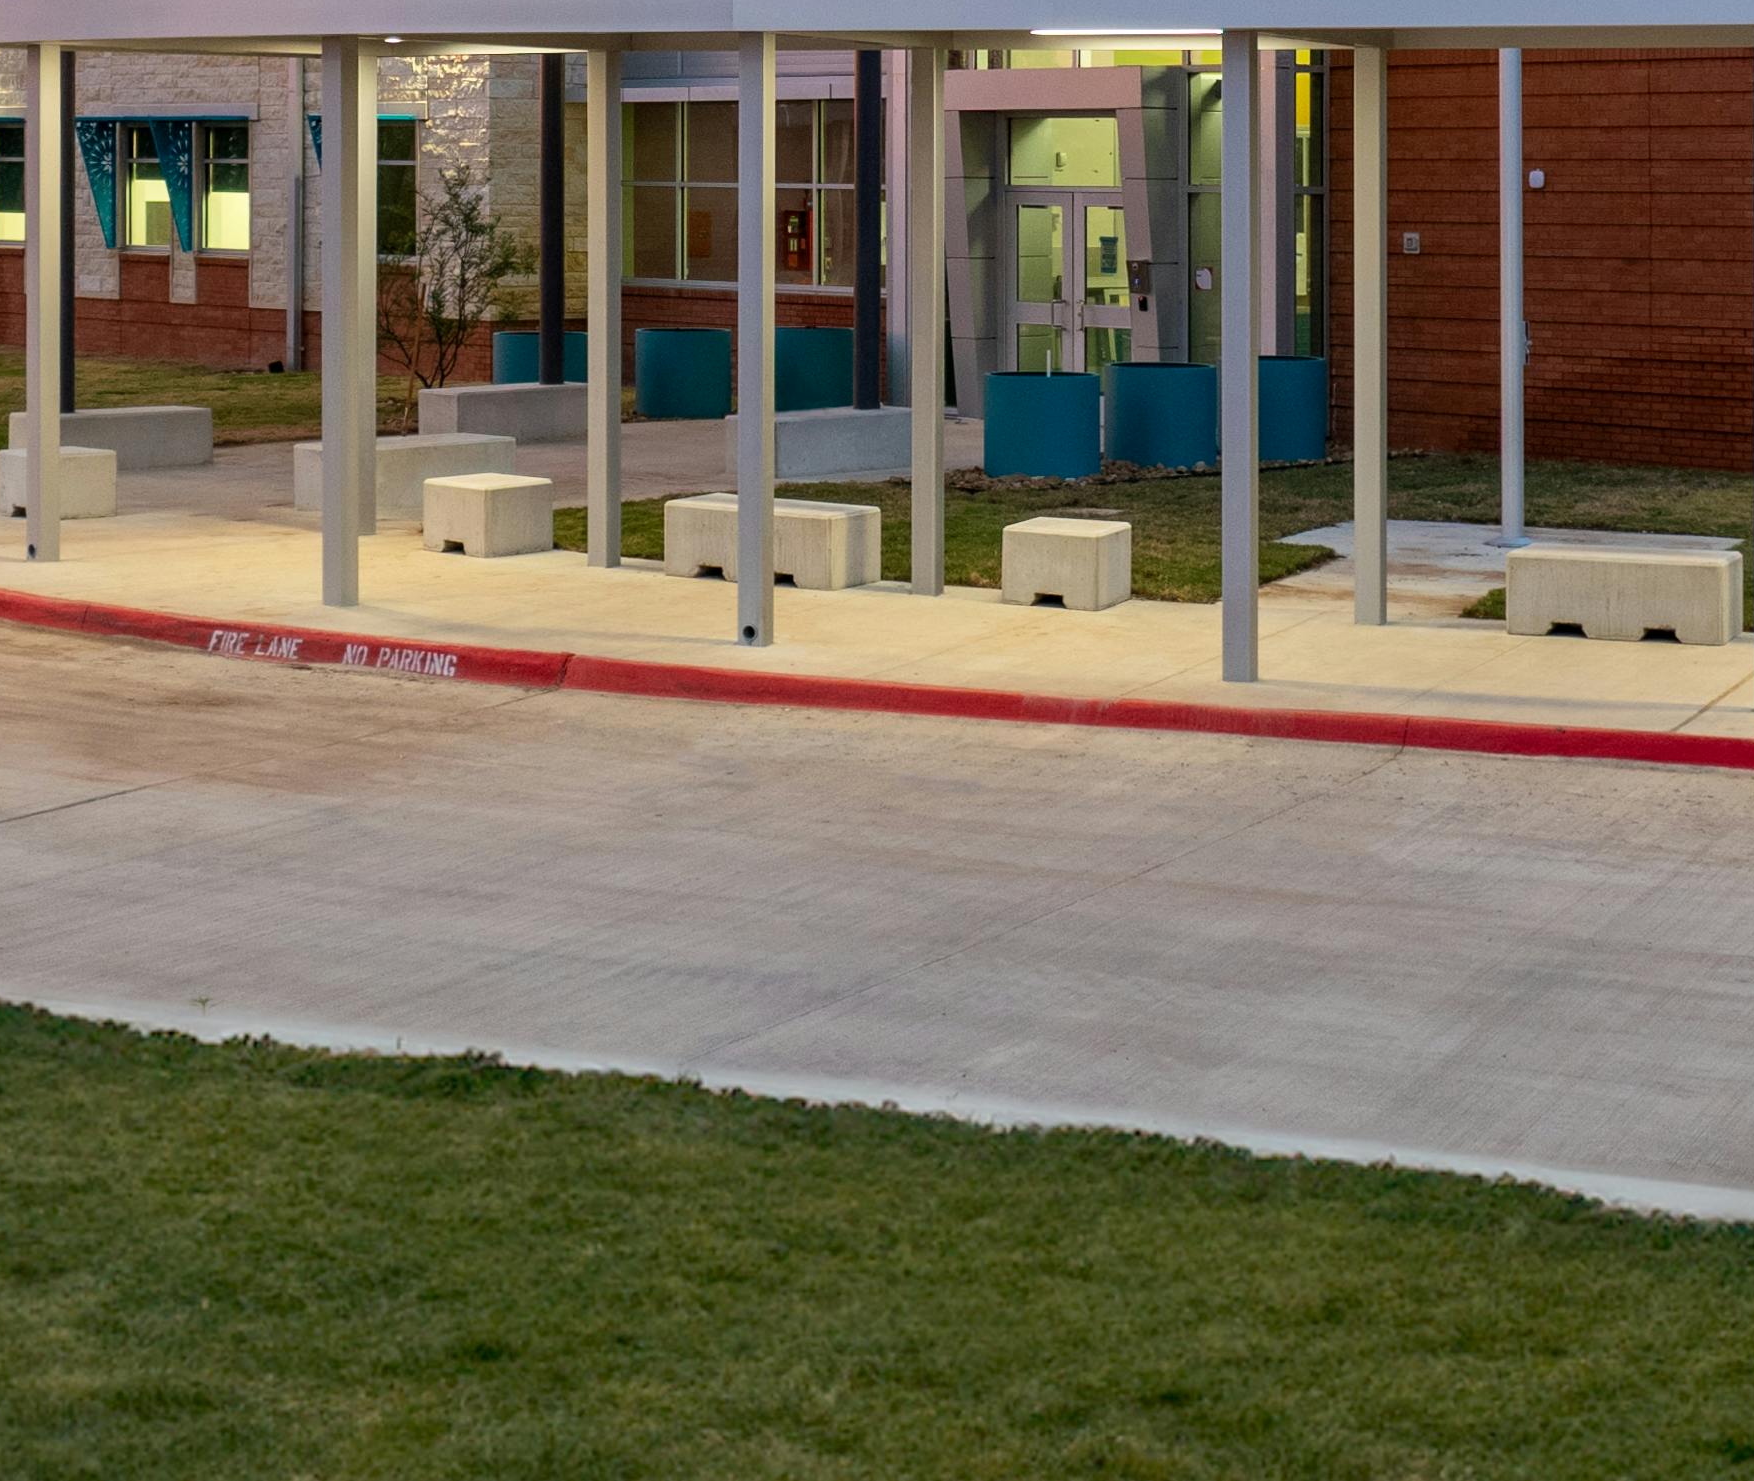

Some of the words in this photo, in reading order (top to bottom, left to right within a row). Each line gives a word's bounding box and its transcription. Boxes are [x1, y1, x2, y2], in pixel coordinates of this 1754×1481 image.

[207, 630, 250, 655] FIRE
[254, 633, 303, 659] LANE
[342, 643, 369, 665] NO
[376, 647, 458, 677] PARKING
